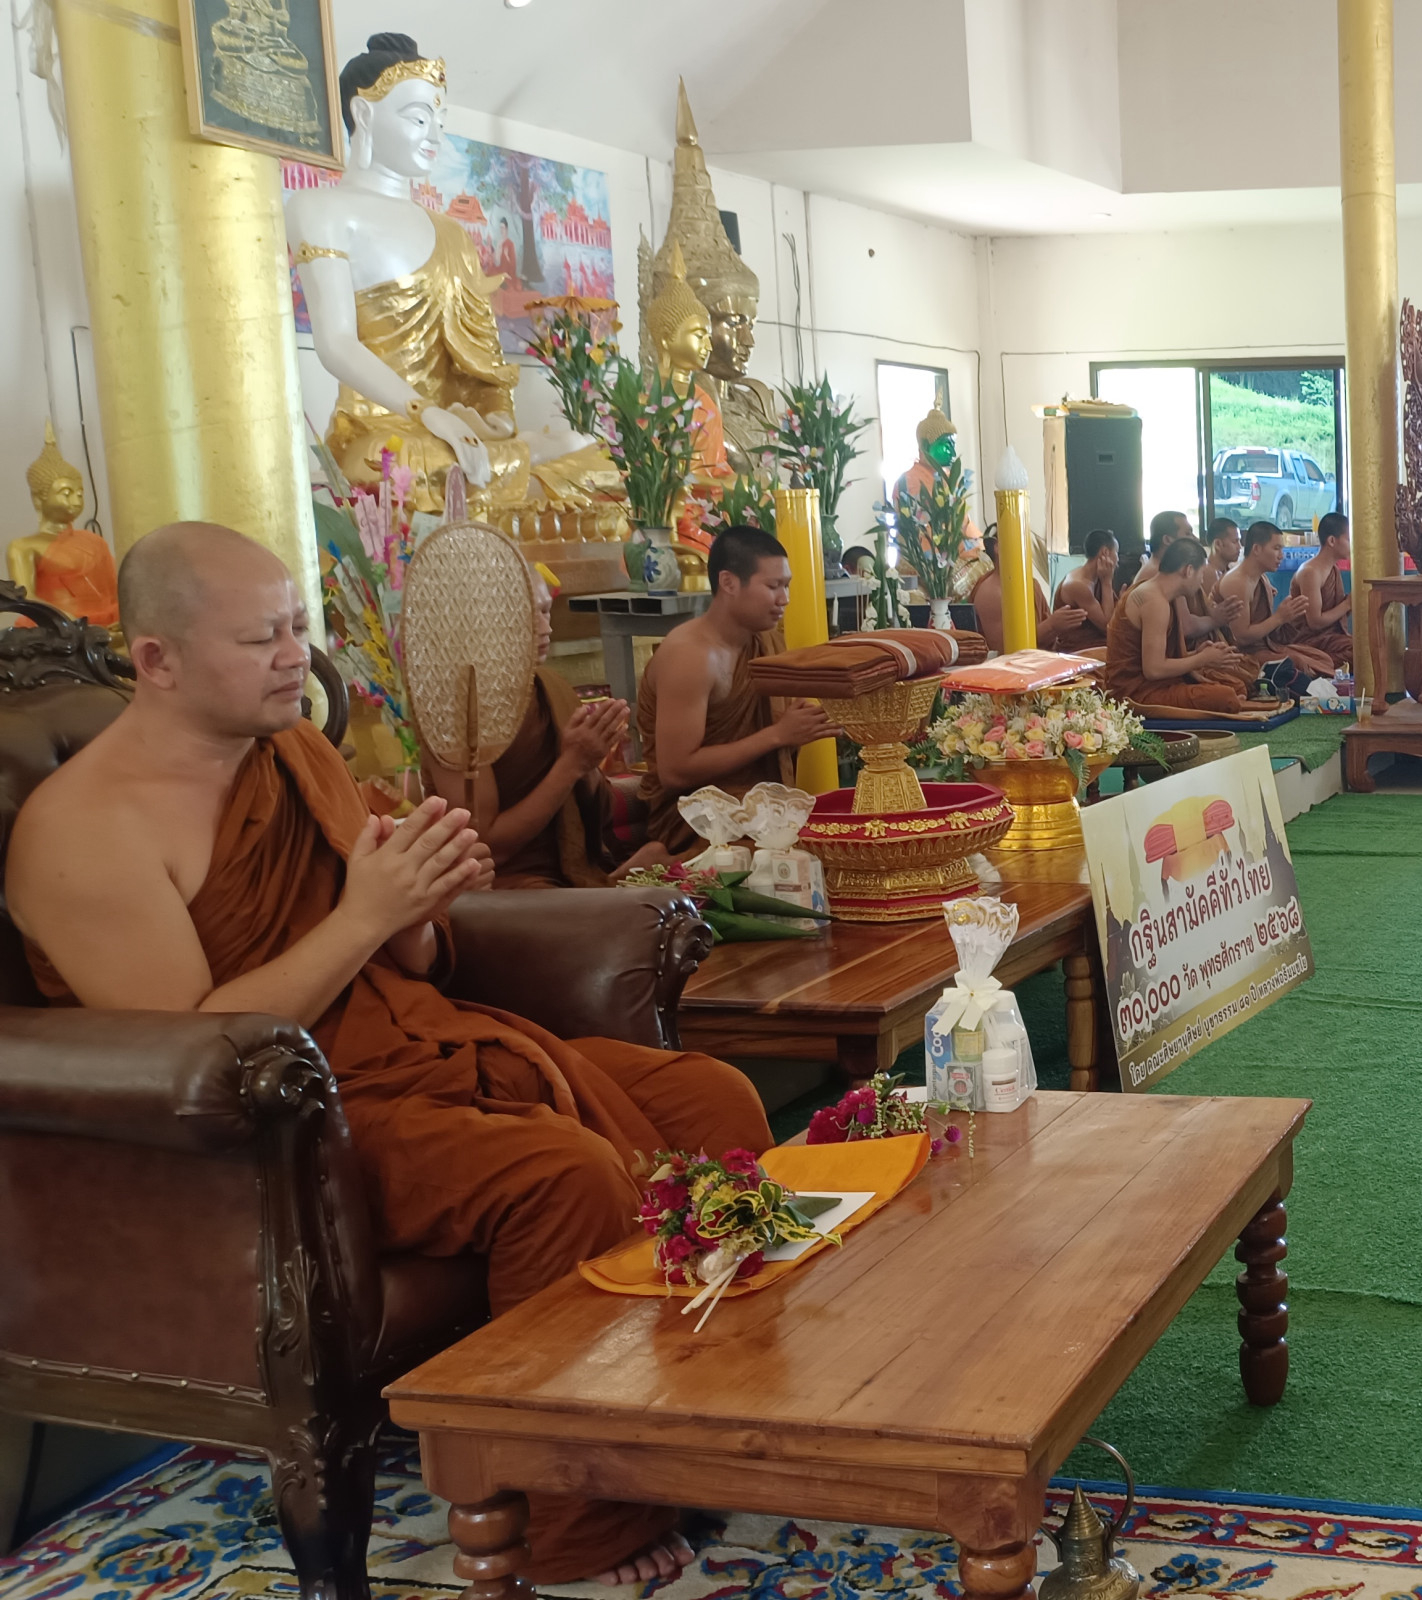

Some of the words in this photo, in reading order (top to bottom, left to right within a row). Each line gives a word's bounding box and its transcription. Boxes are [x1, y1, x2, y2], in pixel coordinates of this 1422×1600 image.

[1119, 974, 1181, 1035] ๓๐,๐๐๐
[1182, 962, 1199, 991] วัด
[1199, 934, 1255, 990] พุทธศักราช
[1254, 902, 1300, 947] ๒๕๖๘
[1131, 855, 1271, 970] กฐินสามัคคีทั่วไทย
[1129, 1062, 1146, 1086] โดย
